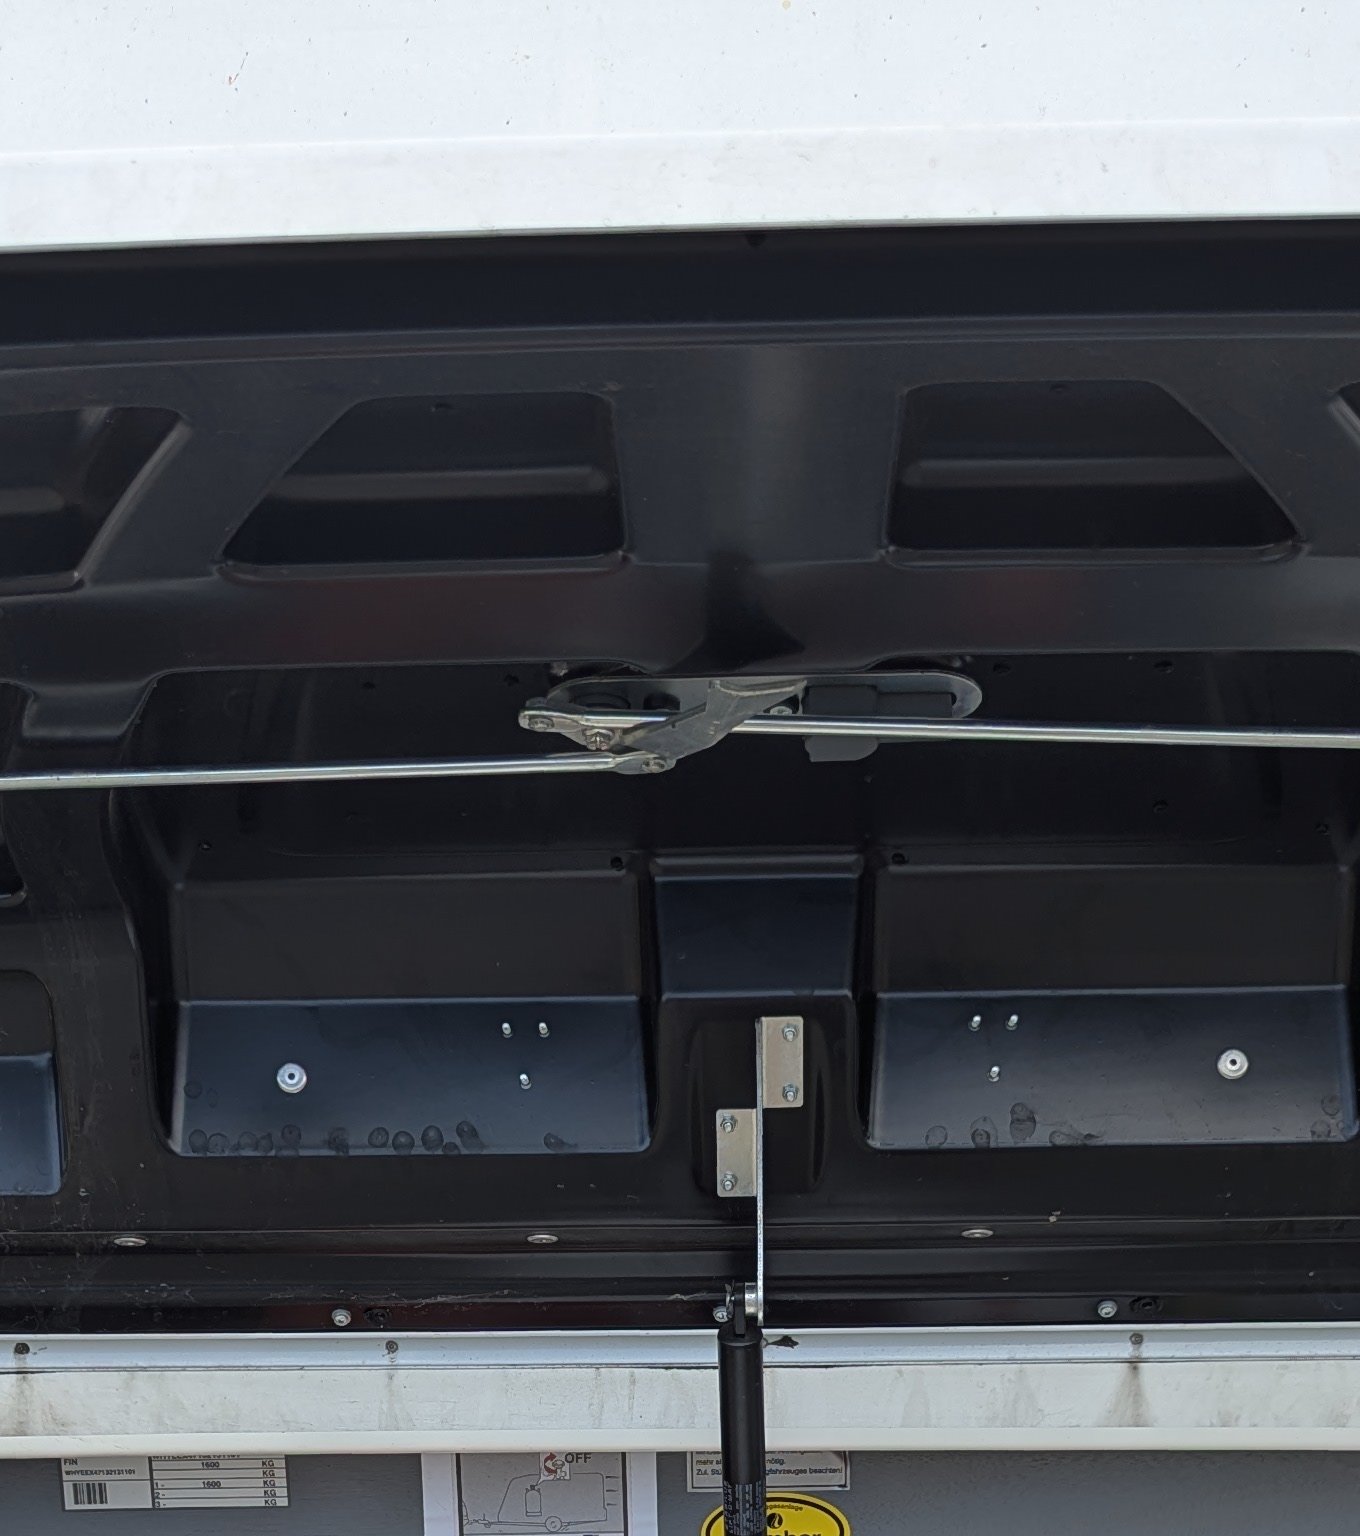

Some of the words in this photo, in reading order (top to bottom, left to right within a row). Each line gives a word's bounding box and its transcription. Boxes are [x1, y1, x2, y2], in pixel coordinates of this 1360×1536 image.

[64, 1458, 78, 1466] FIN
[564, 1452, 592, 1464] OFF
[202, 1461, 220, 1469] 1600
[262, 1469, 275, 1477] KG
[264, 1489, 276, 1497] KG
